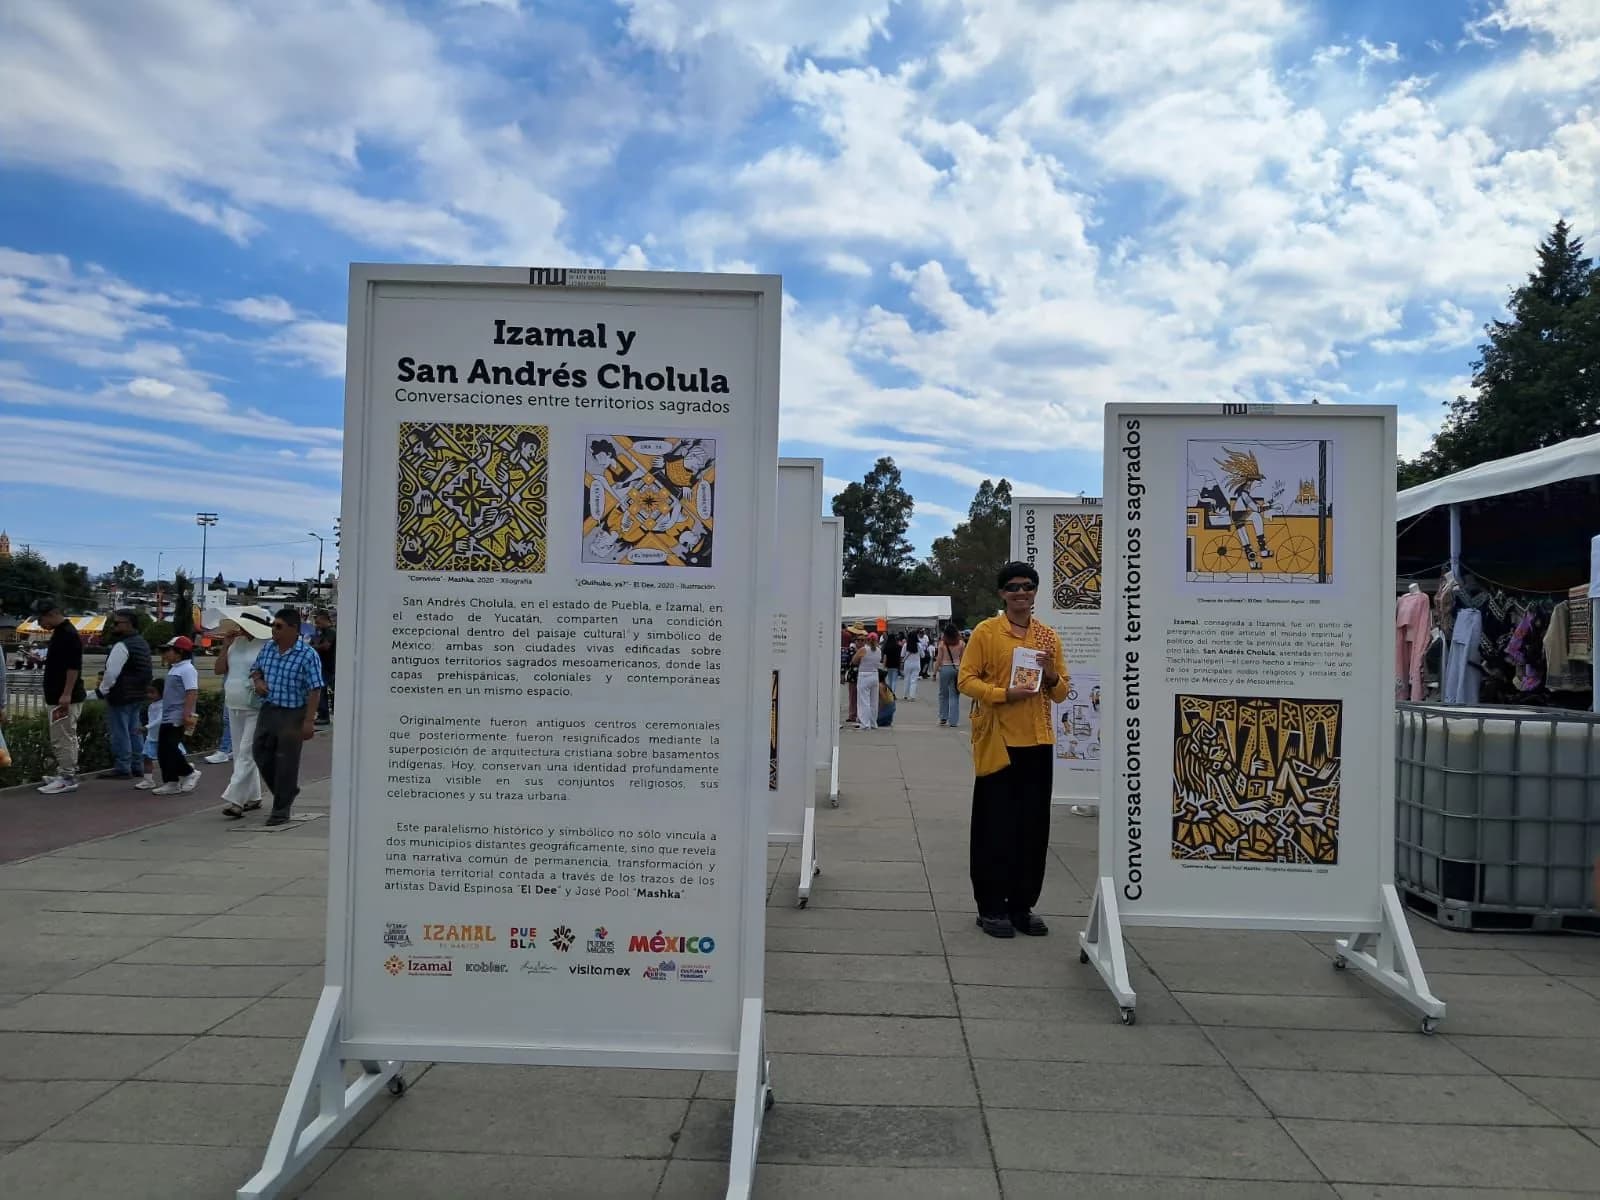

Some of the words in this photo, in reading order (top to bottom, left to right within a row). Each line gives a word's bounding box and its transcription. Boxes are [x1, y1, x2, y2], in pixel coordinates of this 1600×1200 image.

[494, 320, 608, 348] Izamal
[616, 330, 637, 356] y
[398, 357, 459, 384] San
[467, 358, 588, 388] Andrés
[597, 364, 730, 394] Cholula
[394, 388, 523, 406] Conversaciones
[528, 395, 570, 407] entre
[575, 396, 654, 410] territorios
[659, 400, 730, 415] sagrados
[1122, 419, 1146, 520] sagrados
[1122, 527, 1141, 643] territorios
[403, 597, 423, 606] San
[520, 601, 535, 609] en
[538, 600, 548, 609] el
[552, 600, 590, 610] estado
[593, 600, 607, 610] de
[709, 605, 723, 613] en
[392, 611, 402, 621] el
[416, 612, 454, 622] estado
[467, 612, 482, 622] de
[557, 616, 618, 625] comparten
[632, 617, 653, 625] una
[392, 627, 460, 637] excepcional
[467, 627, 505, 637] dentro
[512, 628, 530, 638] del
[537, 629, 576, 640] paisaje
[583, 629, 626, 639] cultural
[633, 632, 640, 641] y
[708, 632, 722, 642] de
[391, 656, 440, 667] antiguos
[445, 656, 502, 666] territorios
[506, 658, 557, 669] sagrados
[666, 660, 701, 670] donde
[706, 660, 721, 670] las
[391, 671, 423, 680] capas
[534, 672, 591, 682] coloniales
[606, 675, 613, 684] y
[1122, 650, 1140, 711] entre
[390, 686, 444, 694] coexisten
[448, 687, 462, 695] en
[484, 688, 523, 696] mismo
[399, 715, 481, 727] Originalmente
[490, 717, 527, 727] fueron
[536, 720, 586, 730] antiguos
[594, 721, 637, 729] centros
[645, 721, 720, 730] ceremoniales
[389, 731, 410, 740] que
[419, 732, 507, 741] posteriormente
[516, 732, 553, 742] fueron
[563, 734, 640, 745] resignificados
[649, 735, 702, 745] mediante
[710, 736, 720, 745] la
[473, 746, 487, 756] de
[491, 748, 560, 757] arquitectura
[564, 749, 613, 758] cristiana
[617, 749, 648, 759] sobre
[652, 749, 720, 759] basamentos
[388, 775, 431, 784] mestiza
[446, 775, 482, 785] visible
[525, 778, 544, 786] sus
[558, 777, 615, 788] conjuntos
[700, 781, 719, 789] sus
[1122, 716, 1142, 900] Conversaciones
[397, 822, 420, 832] Este
[424, 824, 489, 835] paralelismo
[548, 828, 555, 838] y
[619, 830, 634, 838] no
[666, 831, 706, 841] vincula
[386, 837, 406, 847] dos
[409, 839, 472, 849] municipios
[475, 840, 526, 850] distantes
[631, 845, 655, 854] sino
[658, 846, 679, 856] que
[682, 846, 716, 856] revela
[385, 868, 436, 877] memoria
[441, 869, 494, 879] territorial
[499, 870, 545, 880] contada
[600, 872, 614, 882] de
[619, 873, 636, 883] los
[641, 874, 675, 884] trazos
[680, 875, 694, 885] de
[699, 876, 715, 886] los
[384, 882, 424, 891] artistas
[428, 881, 460, 892] David
[464, 883, 513, 894] Espinosa
[565, 888, 571, 897] y
[605, 887, 629, 897] Pool
[423, 924, 496, 941] IZAMAL
[510, 927, 536, 937] PUE
[408, 960, 452, 972] Izamal
[569, 963, 631, 976] visitamex
